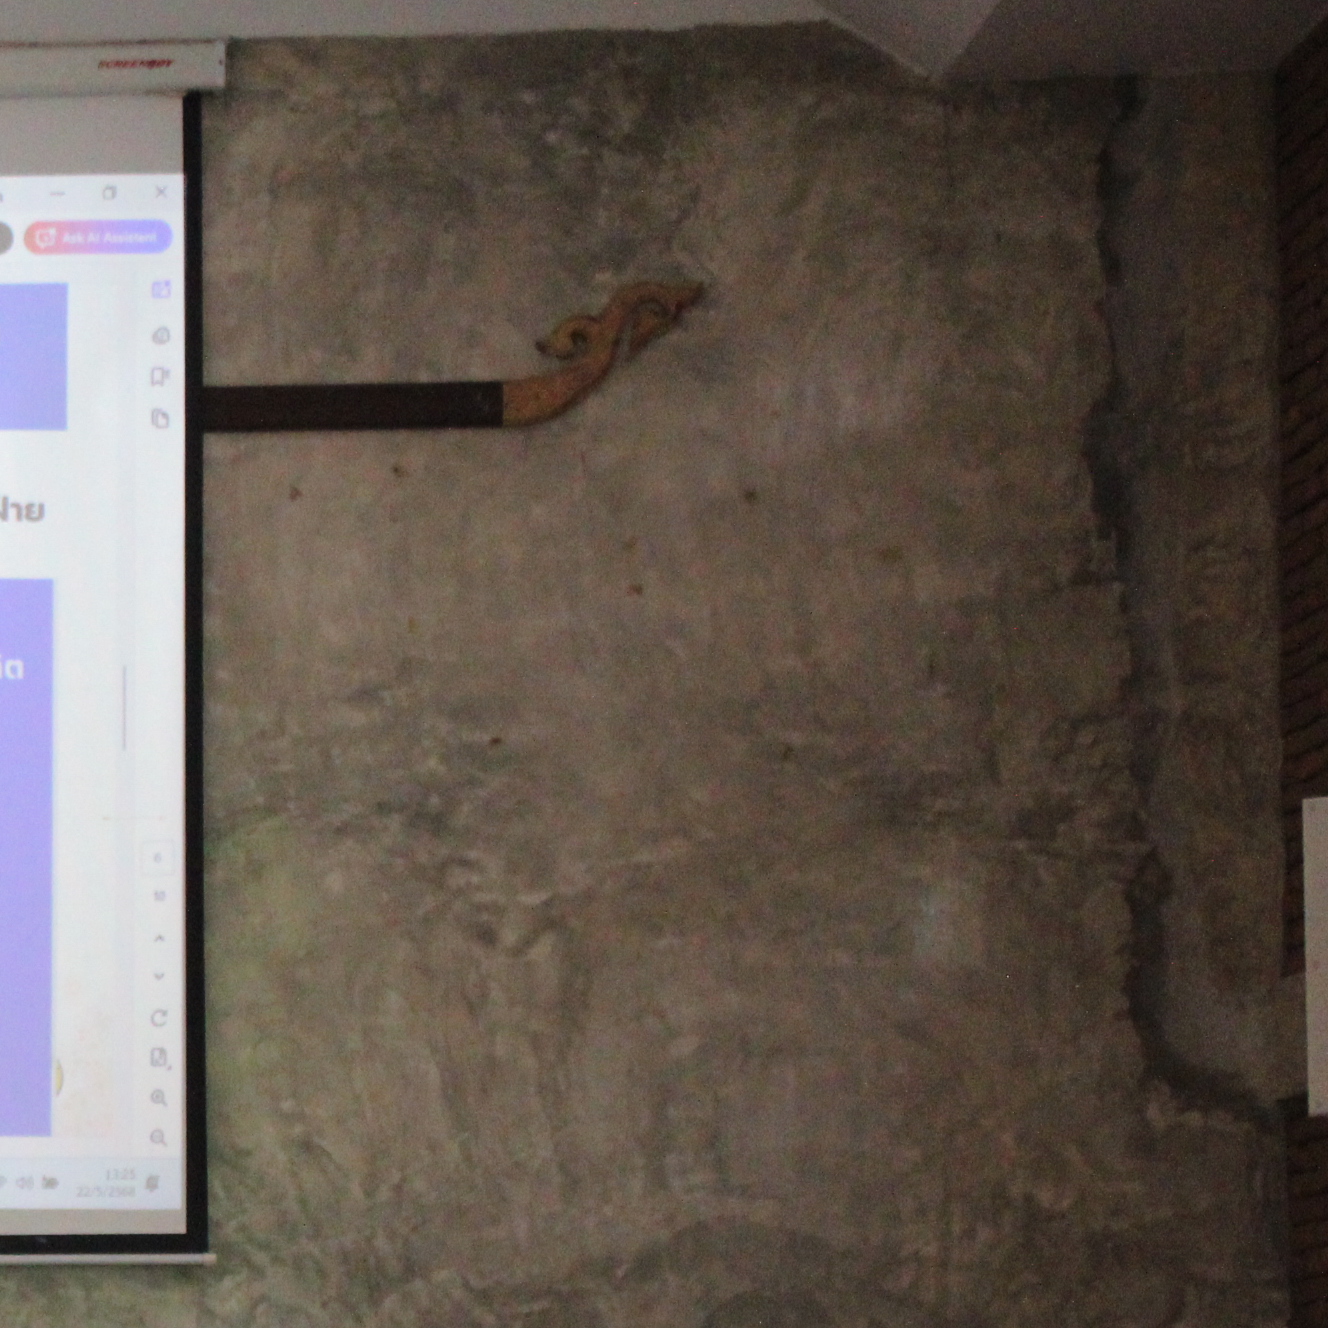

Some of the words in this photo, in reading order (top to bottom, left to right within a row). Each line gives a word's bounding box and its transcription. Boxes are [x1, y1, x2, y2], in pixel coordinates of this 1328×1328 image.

[62, 230, 82, 245] Ask
[85, 230, 99, 245] AI
[103, 228, 158, 245] Assistant
